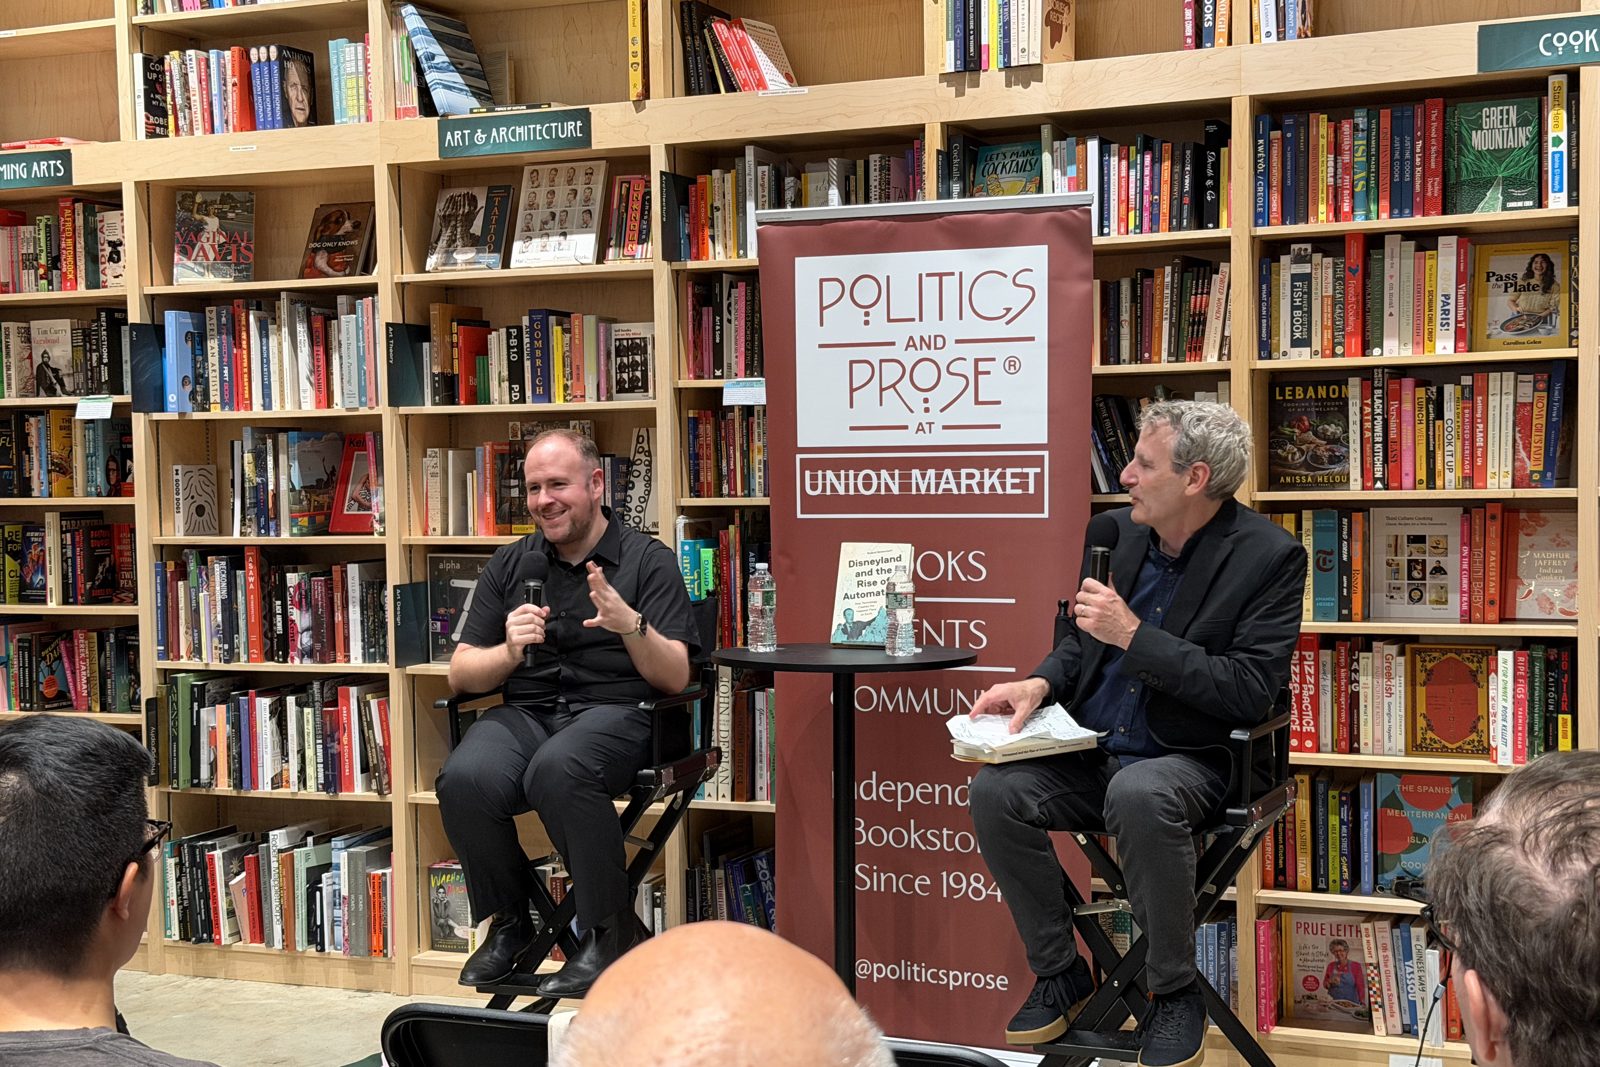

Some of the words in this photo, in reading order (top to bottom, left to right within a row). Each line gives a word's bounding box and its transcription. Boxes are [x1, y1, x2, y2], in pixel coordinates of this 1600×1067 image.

[1539, 29, 1599, 56] COOK
[282, 50, 311, 63] ANTHONY
[1552, 86, 1561, 106] Start
[1482, 106, 1516, 129] GREEN
[1553, 108, 1561, 129] Here
[445, 130, 470, 148] ART
[474, 128, 488, 144] &
[490, 121, 583, 143] ARCHITECTURE
[1472, 126, 1532, 150] MOUNTAINS
[952, 144, 960, 181] Cocktails
[982, 157, 1038, 177] COCKTAILS!
[985, 152, 1007, 162] LET'S
[1010, 148, 1038, 160] MAKE
[1206, 151, 1216, 177] Death
[1354, 139, 1366, 192] ISLAS
[32, 160, 64, 178] ARTS
[1206, 191, 1215, 202] Co
[64, 209, 72, 236] ALFRED
[486, 197, 502, 252] TATTOO
[175, 230, 254, 244] VAGINAL
[66, 239, 74, 279] HITCHCOCK
[99, 214, 108, 288] RADICAL
[175, 244, 255, 263] DAVIS
[1218, 270, 1227, 297] SPIRITED
[1486, 271, 1518, 283] Pass
[1503, 281, 1540, 294] Plate
[818, 268, 1037, 327] POLITICS
[1293, 282, 1302, 306] FISH
[1457, 283, 1467, 320] Vitamina
[1214, 300, 1223, 320] WOMEN
[1440, 294, 1451, 332] PARIS!
[49, 327, 67, 336] Curry
[1293, 310, 1302, 340] BOOK
[904, 335, 946, 351] AND
[534, 321, 544, 395] GOMBRICH
[512, 384, 520, 402] P.D.
[1275, 385, 1349, 400] LEBANON
[1374, 389, 1383, 413] BLACK
[915, 422, 935, 434] AT
[1364, 399, 1372, 438] YATRA
[1374, 415, 1383, 441] POWER
[1390, 401, 1399, 438] Persiana
[1445, 418, 1454, 447] COOK
[1476, 424, 1484, 447] PLACE
[1373, 443, 1383, 478] KITCHEN
[1446, 449, 1454, 458] IT
[1446, 461, 1454, 473] UP
[804, 470, 900, 496] UNION
[911, 468, 1041, 495] MARKET
[439, 562, 460, 571] alpha
[848, 554, 902, 568] Disneyland
[855, 569, 873, 578] and
[876, 567, 892, 575] the
[912, 551, 987, 582] OKS
[1472, 547, 1483, 578] TAHINI
[857, 580, 878, 588] Rise
[1473, 581, 1484, 608] BABY
[78, 634, 86, 658] DEREK
[439, 637, 447, 645] in
[80, 660, 88, 696] JARMAN
[1385, 654, 1394, 697] Greekish
[1517, 656, 1525, 676] RIPE
[720, 677, 729, 716] JOHN
[1517, 678, 1525, 699] FIGS
[1302, 684, 1314, 733] PRACTICE
[720, 729, 729, 785] DERIAN
[1397, 784, 1414, 793] THE
[1417, 785, 1457, 794] SPANISH
[1387, 810, 1467, 821] MEDITERRANEAN
[855, 818, 982, 854] Booksto
[854, 864, 930, 896] Since
[940, 871, 1002, 902] 1984
[1219, 931, 1227, 945] Why
[1295, 921, 1326, 936] PRUE
[1329, 922, 1362, 938] LEITH
[1416, 944, 1425, 972] CHINESE
[855, 958, 1008, 990] @politicsprose
[1405, 960, 1415, 1000] YASSOU
